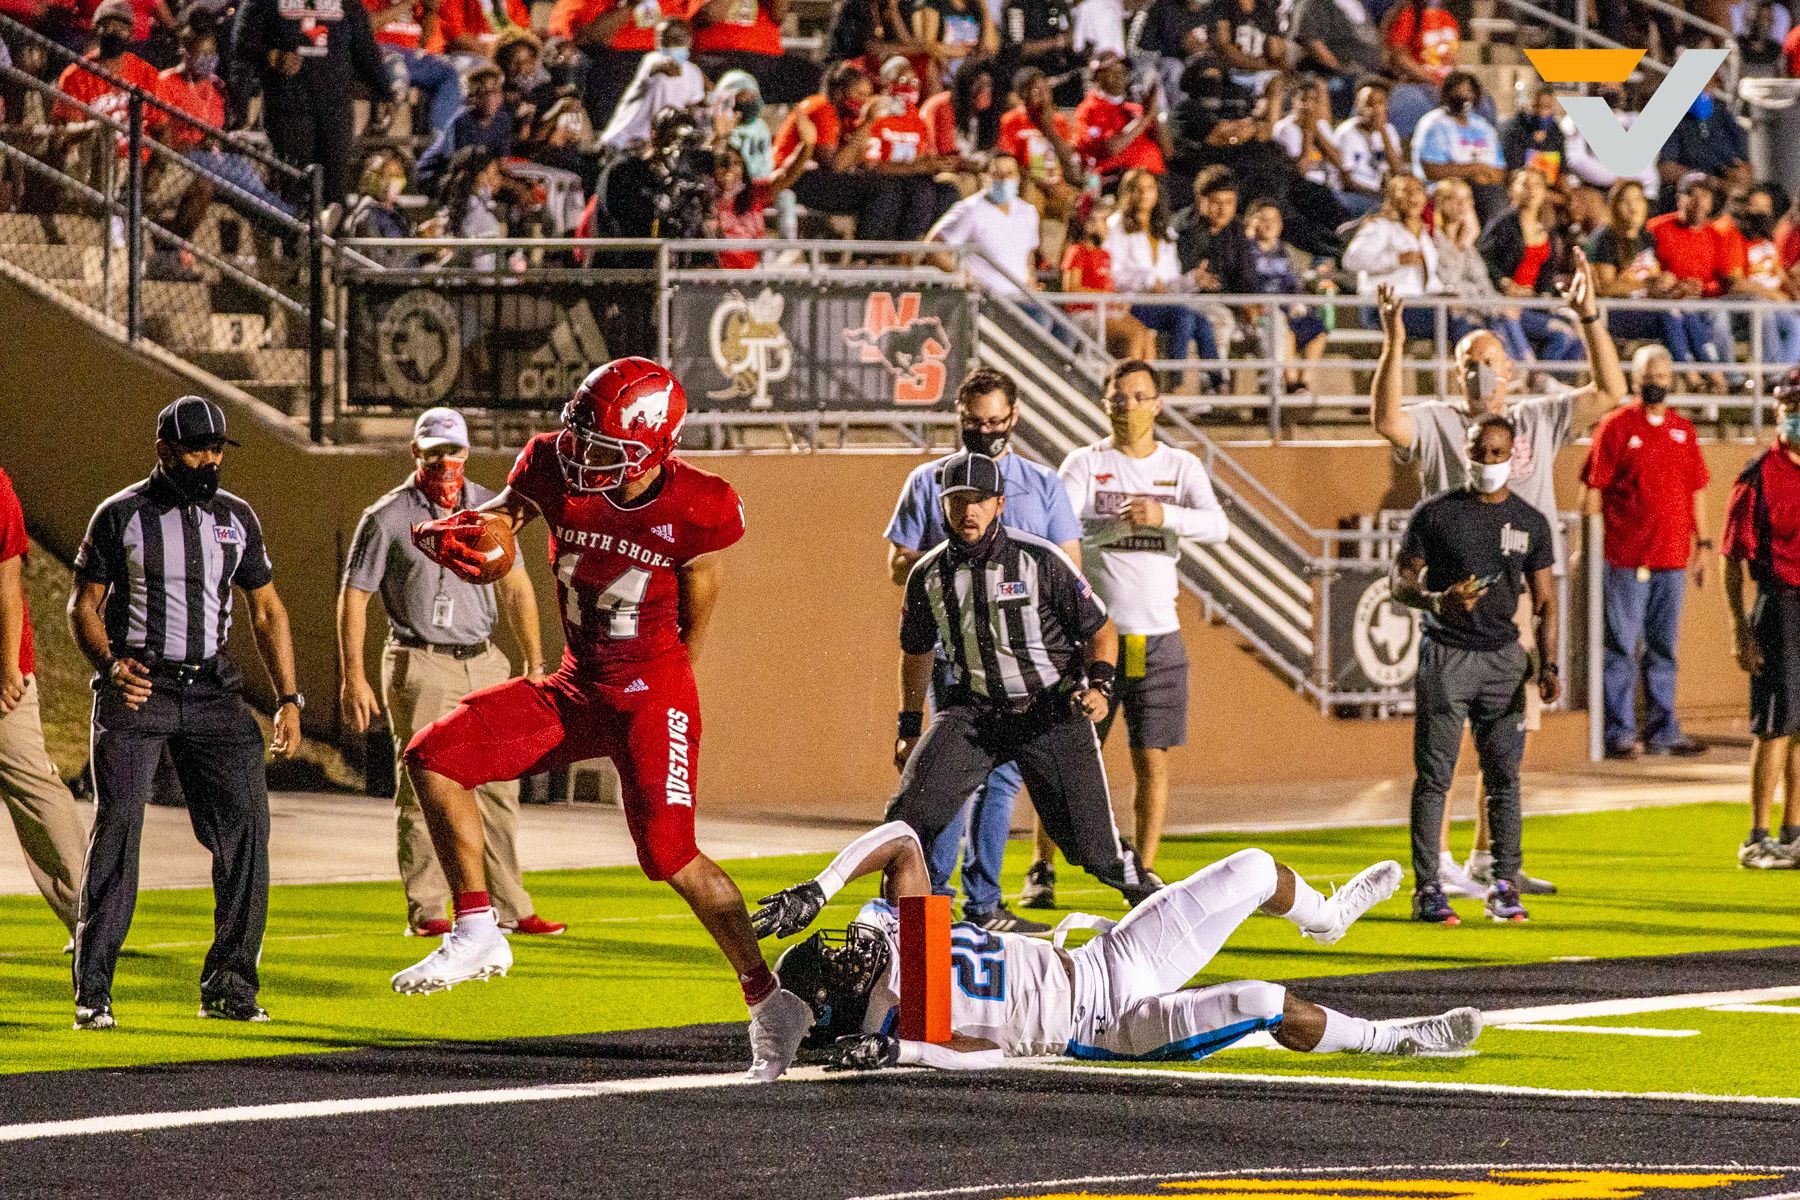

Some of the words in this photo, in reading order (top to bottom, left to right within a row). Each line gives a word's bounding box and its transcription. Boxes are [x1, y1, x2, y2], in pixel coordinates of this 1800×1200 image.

[555, 525, 614, 551] NORTH
[617, 539, 674, 568] SHORE
[557, 552, 652, 639] 14
[666, 707, 692, 808] MUSTANGS
